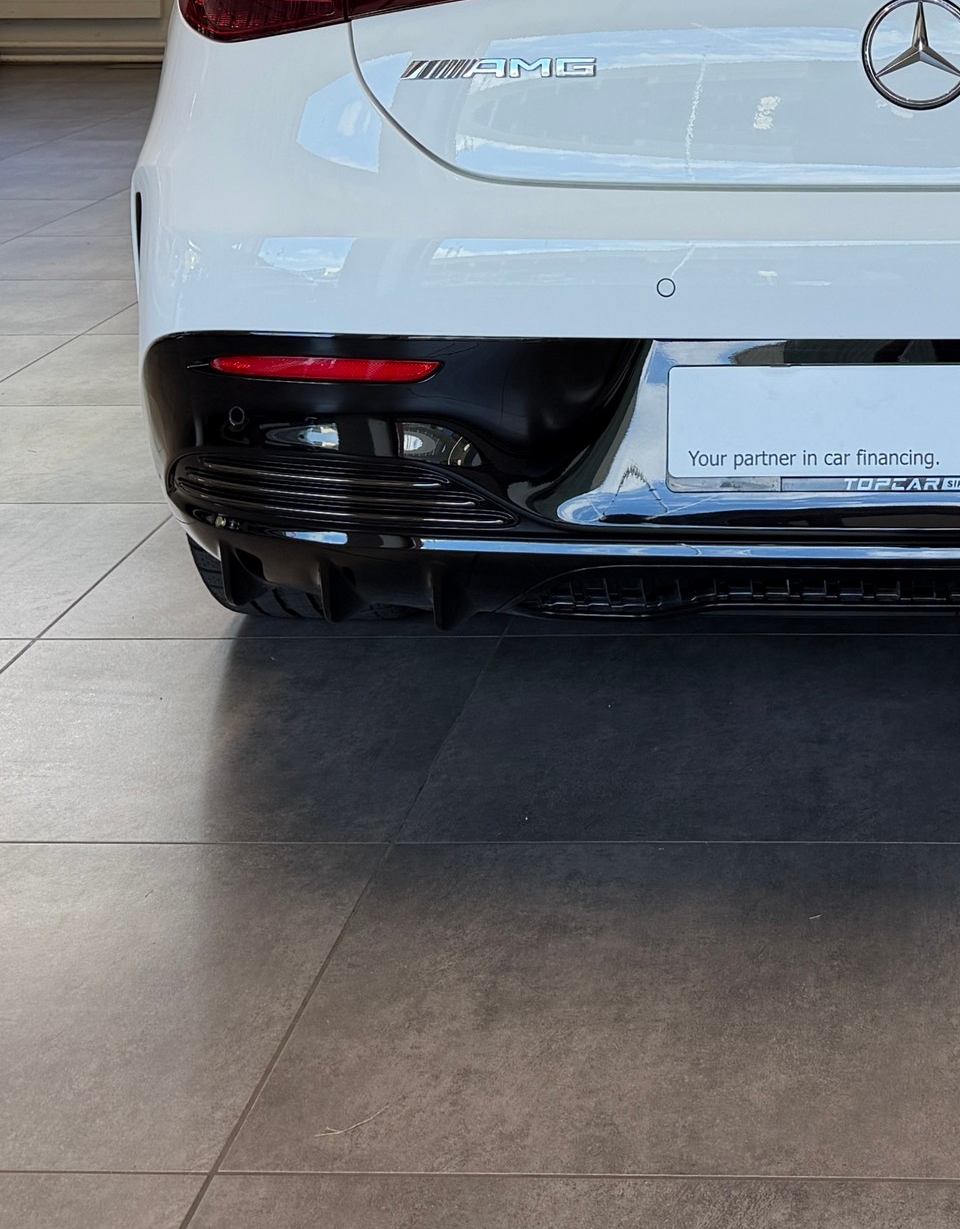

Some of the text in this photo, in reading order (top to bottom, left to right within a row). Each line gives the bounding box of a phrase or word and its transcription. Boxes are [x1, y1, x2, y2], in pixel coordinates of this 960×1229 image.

[462, 57, 597, 79] AMG
[688, 449, 940, 470] Your partner in car financing.
[844, 478, 941, 490] TOPCAR
